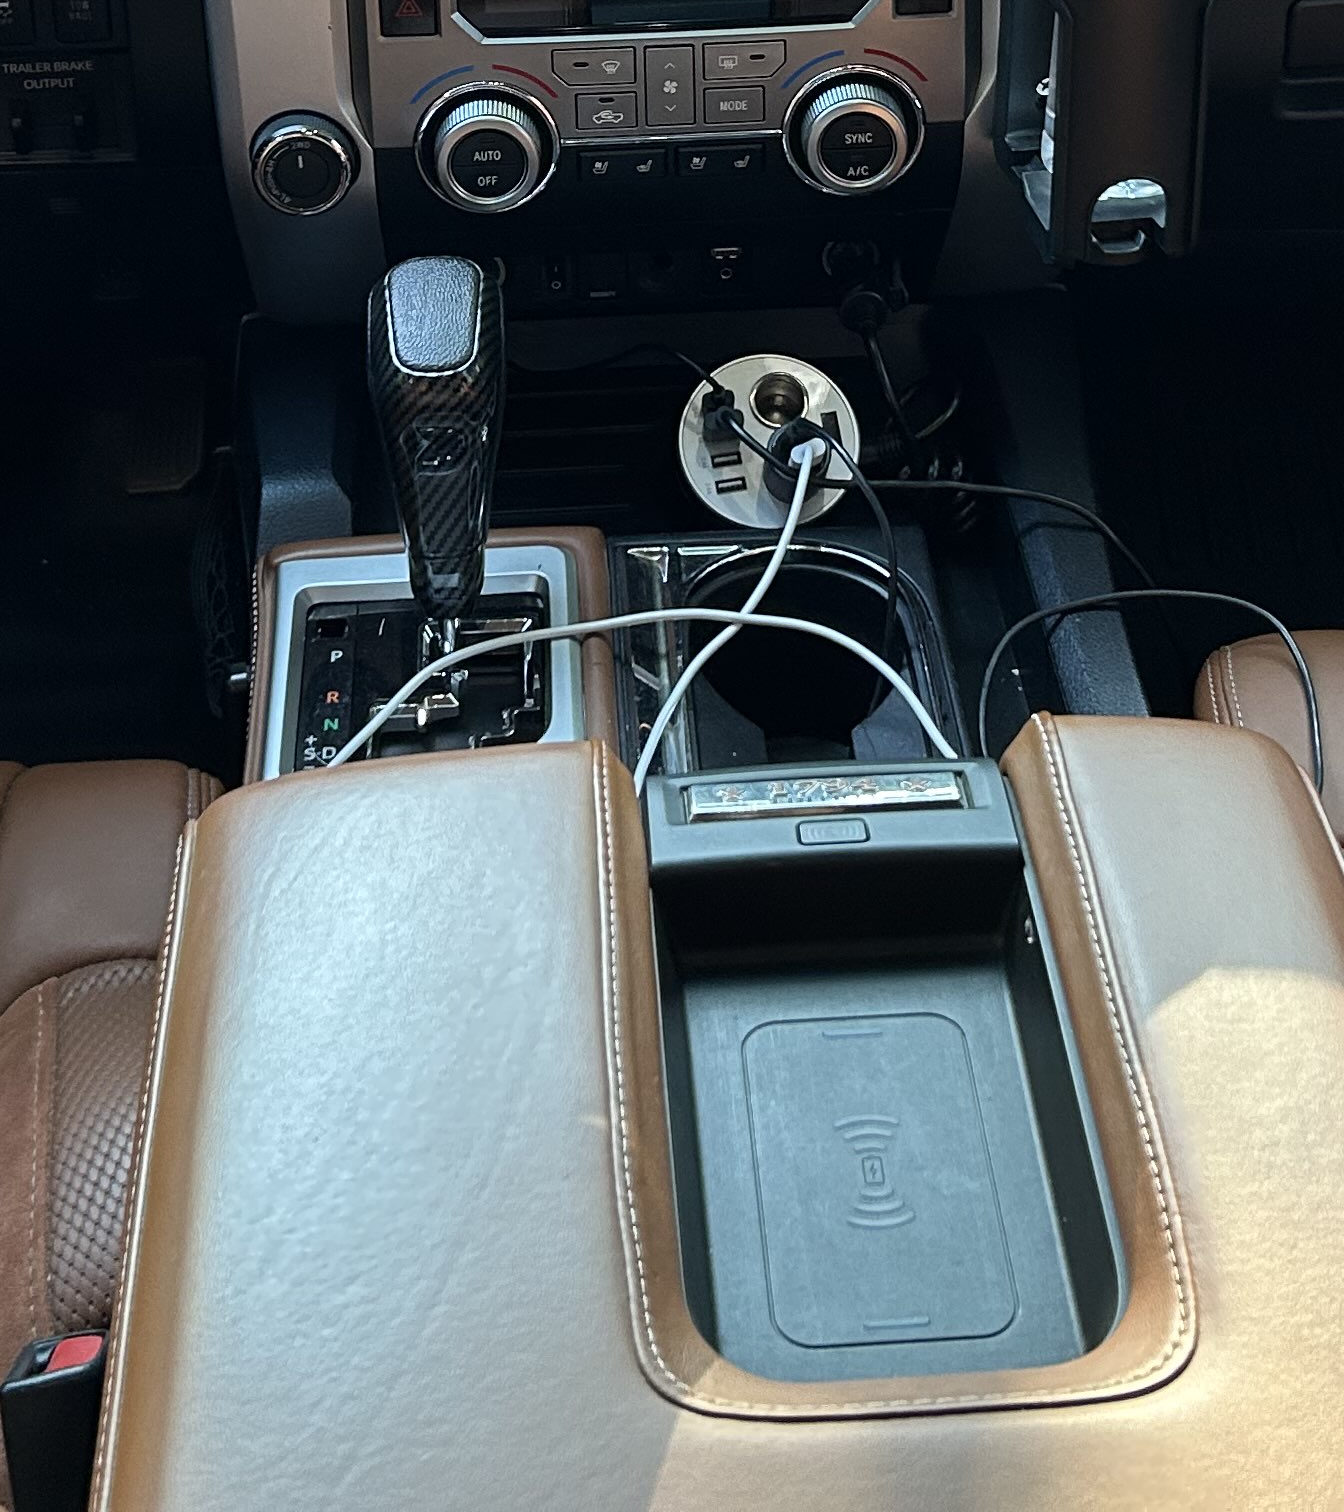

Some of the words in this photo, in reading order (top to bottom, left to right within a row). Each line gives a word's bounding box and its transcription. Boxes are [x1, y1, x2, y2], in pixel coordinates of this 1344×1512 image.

[2, 62, 52, 74] TRAILER
[53, 60, 94, 72] BRAKE
[23, 77, 75, 90] OUTPUT
[719, 99, 749, 111] MODE
[844, 132, 873, 145] SYNC
[472, 149, 502, 162] AUTO
[846, 165, 870, 177] A/C
[477, 175, 499, 187] OFF
[330, 650, 344, 663] P
[325, 690, 340, 704] R
[323, 718, 339, 732] N
